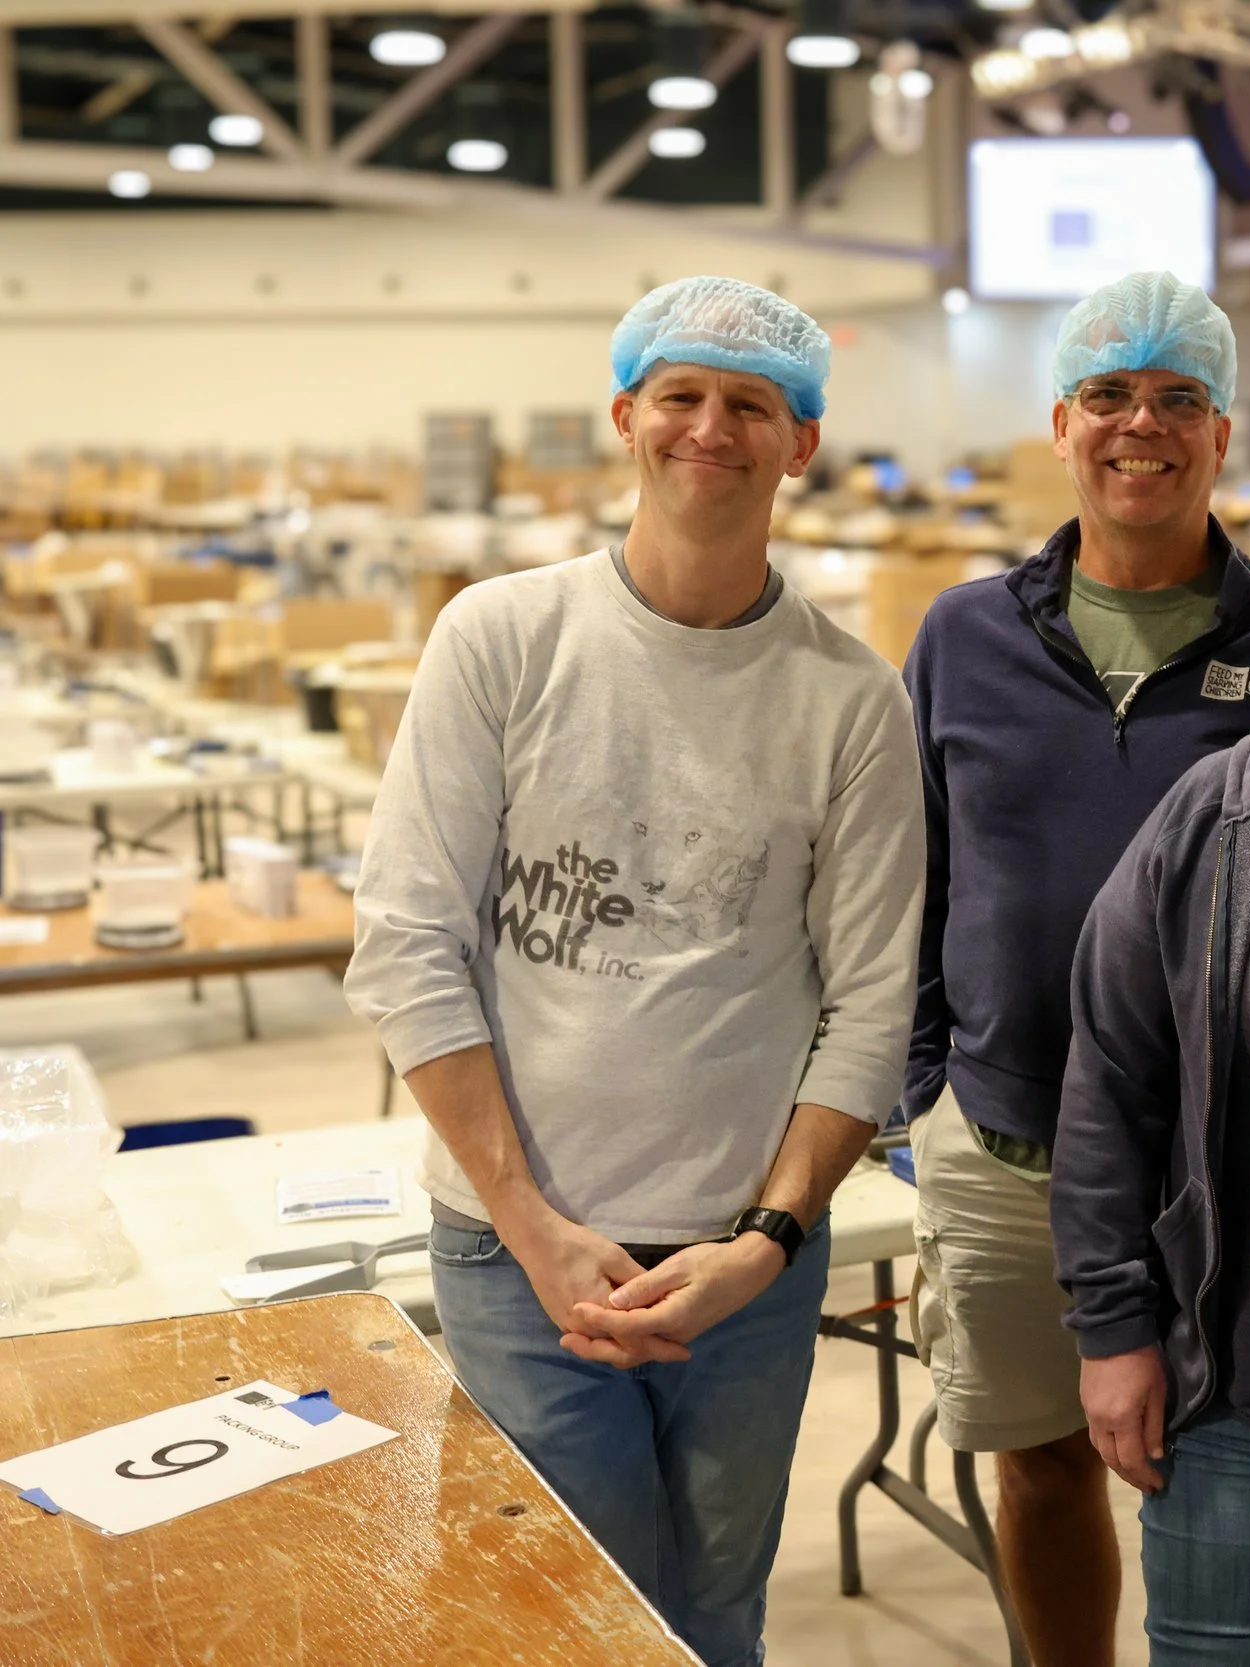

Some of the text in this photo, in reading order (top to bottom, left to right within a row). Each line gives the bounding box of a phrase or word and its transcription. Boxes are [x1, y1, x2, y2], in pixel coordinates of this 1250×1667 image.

[1205, 684, 1242, 698] CHILDREN
[1210, 664, 1245, 681] FEED MY
[556, 840, 619, 884] the
[500, 847, 635, 928] White
[596, 950, 645, 980] inc.
[213, 1413, 300, 1451] PACKING GROUP
[115, 1438, 230, 1480] 9
